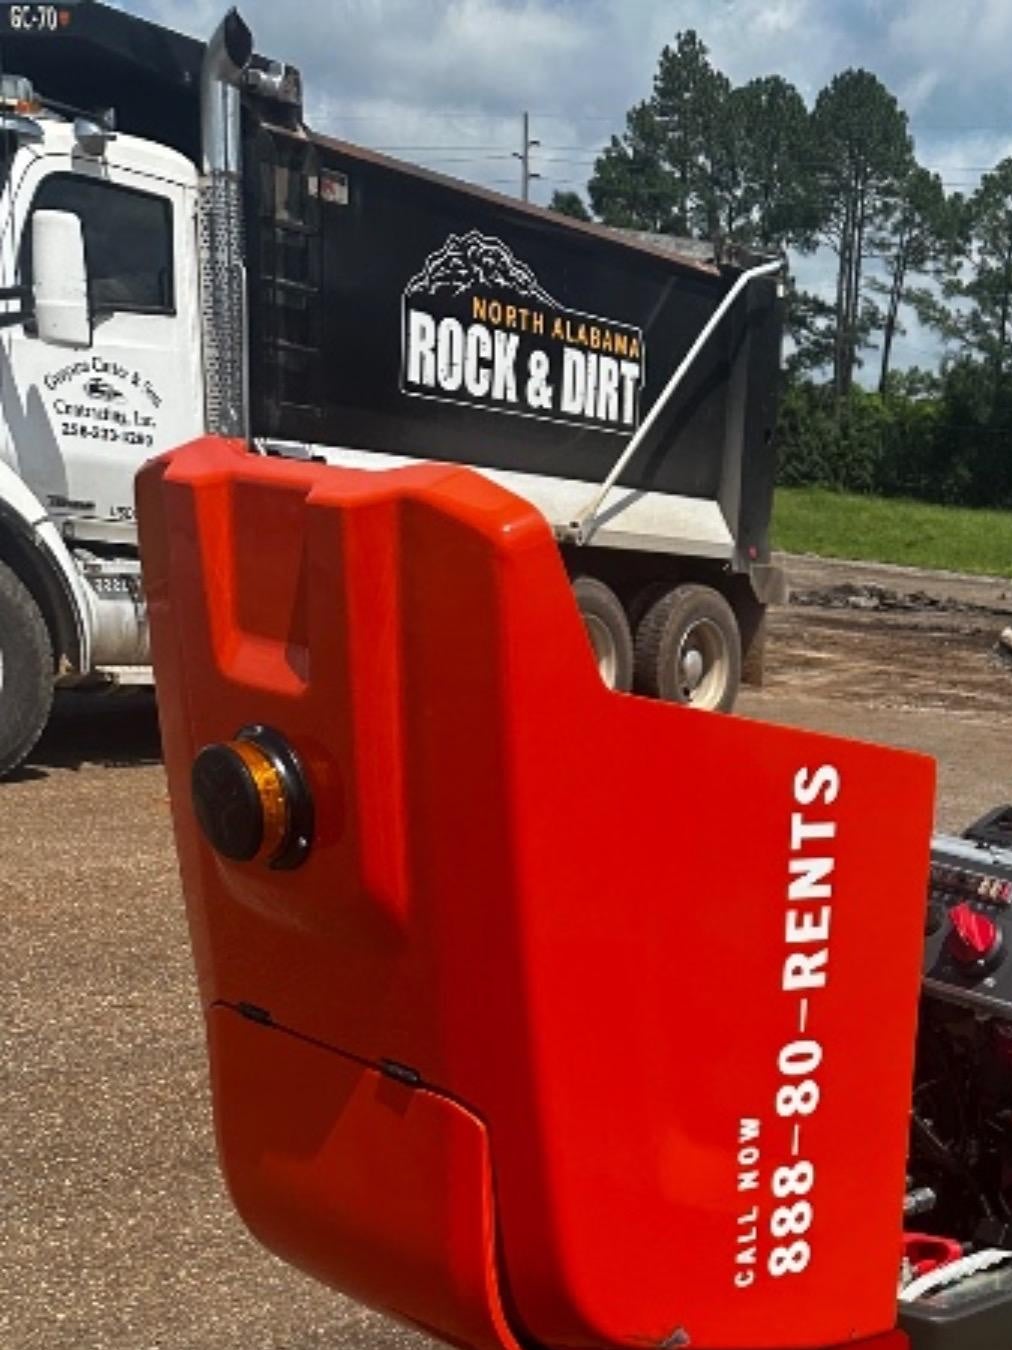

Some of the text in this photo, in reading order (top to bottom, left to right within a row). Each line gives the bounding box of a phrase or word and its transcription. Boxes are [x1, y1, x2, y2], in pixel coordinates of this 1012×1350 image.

[407, 309, 640, 425] ROCK & DIRT
[472, 296, 640, 359] NORTH ALABAMA
[767, 762, 841, 1277] 888-80-RENTS
[733, 1117, 762, 1288] CALL NOW
